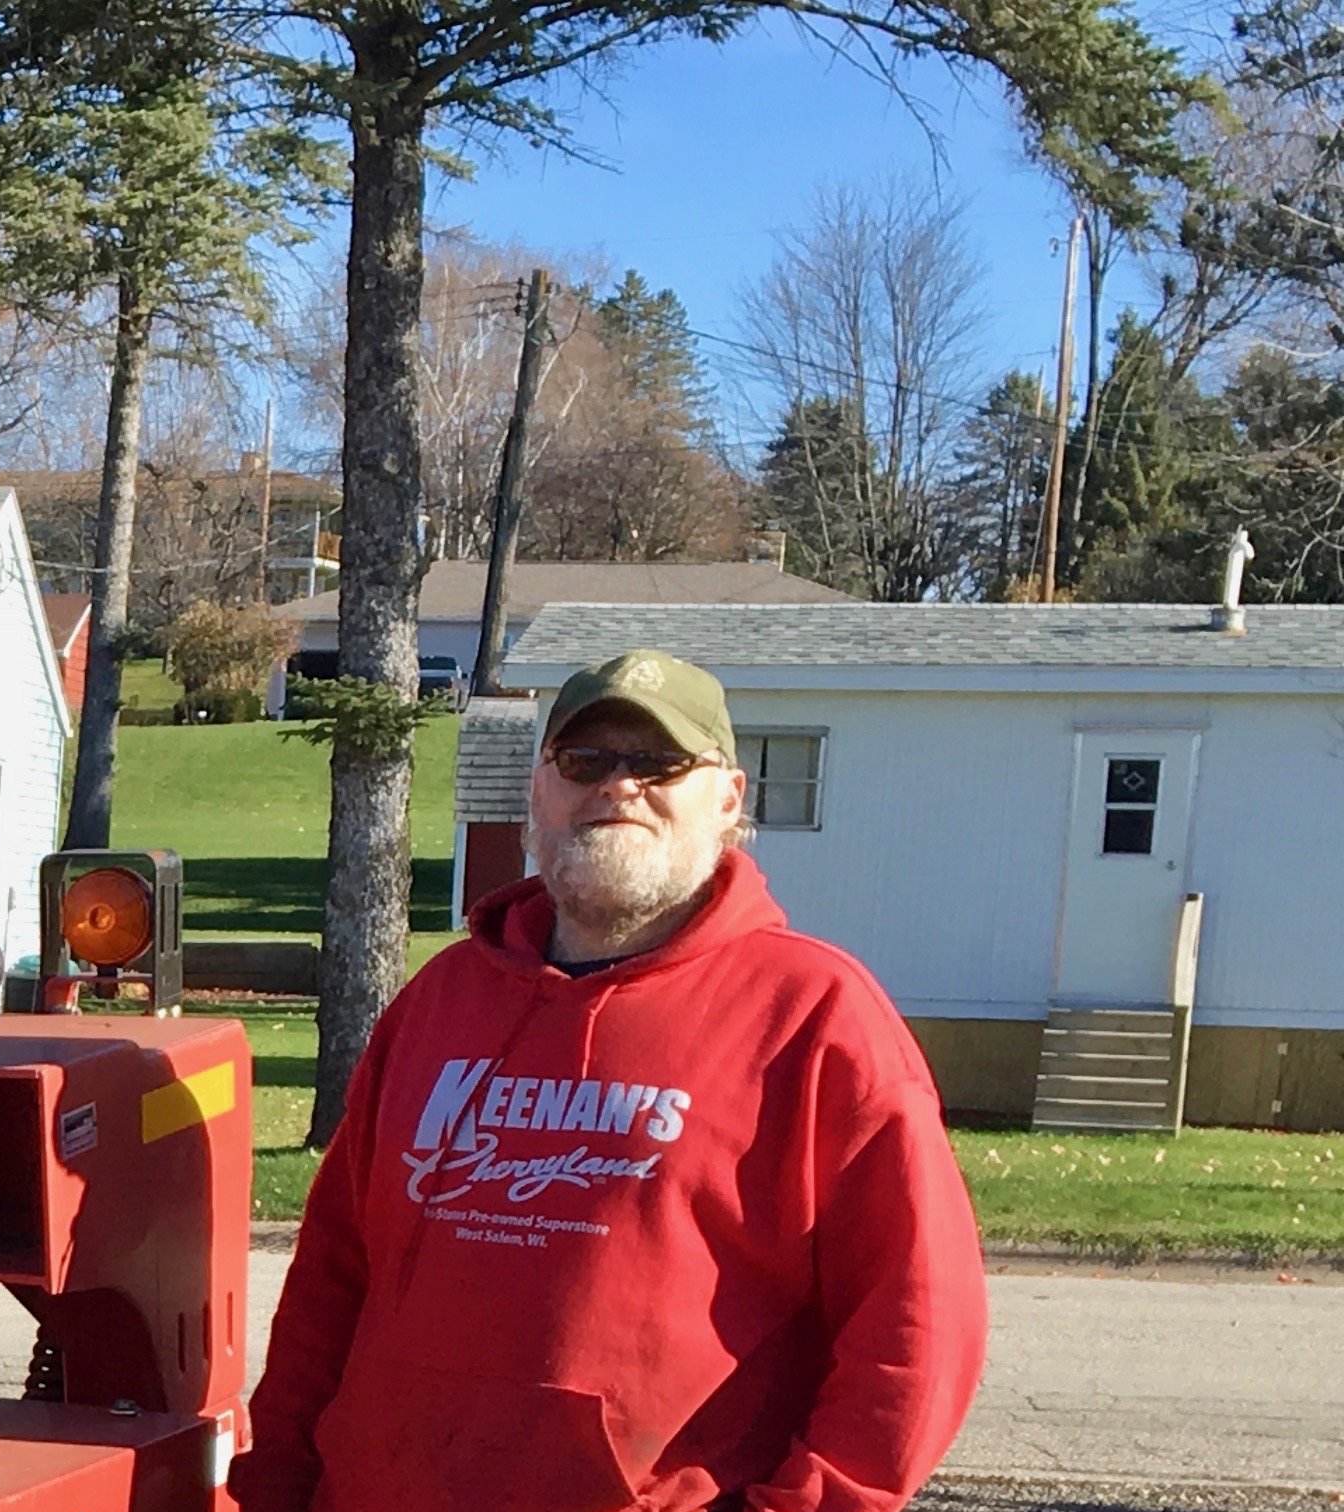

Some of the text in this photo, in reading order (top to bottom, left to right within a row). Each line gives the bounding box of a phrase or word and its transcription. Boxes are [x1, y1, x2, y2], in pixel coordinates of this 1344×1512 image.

[413, 1057, 692, 1150] KEENAN'S
[401, 1132, 663, 1204] Cherryland
[455, 1226, 483, 1241] West
[468, 1208, 534, 1227] Pre-owned
[535, 1215, 610, 1236] Superstore
